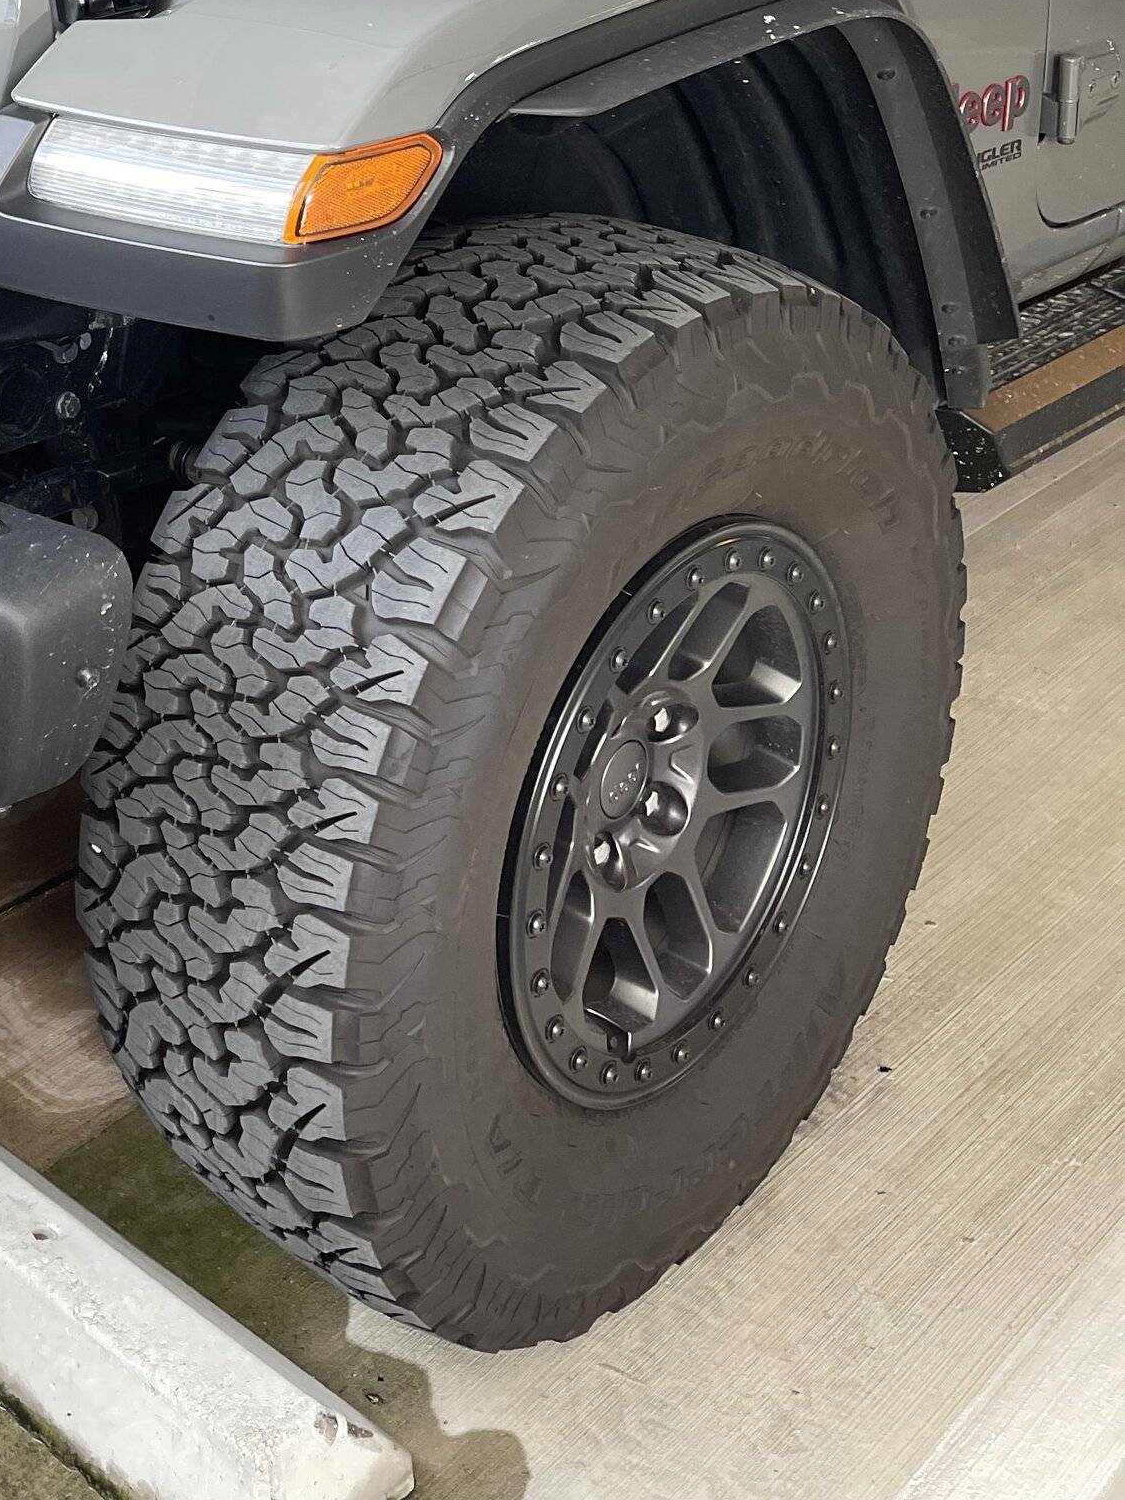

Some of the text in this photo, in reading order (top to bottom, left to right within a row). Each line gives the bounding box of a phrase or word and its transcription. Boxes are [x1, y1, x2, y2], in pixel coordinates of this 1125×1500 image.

[953, 74, 1030, 134] eep
[977, 139, 1022, 164] GLER
[981, 152, 1022, 171] IMITED
